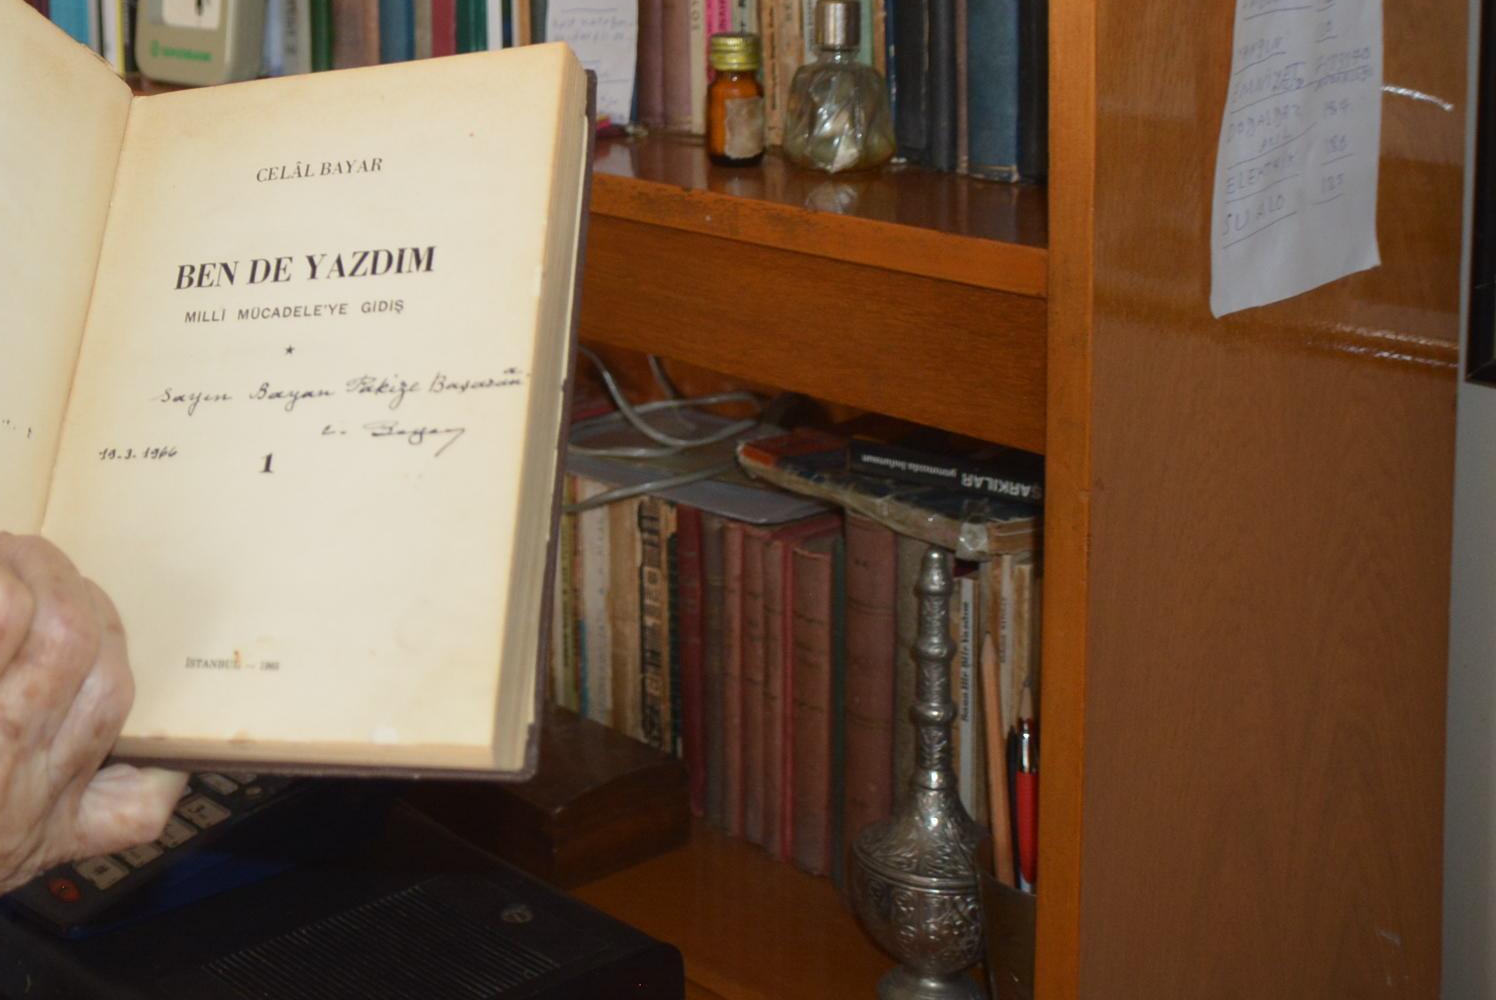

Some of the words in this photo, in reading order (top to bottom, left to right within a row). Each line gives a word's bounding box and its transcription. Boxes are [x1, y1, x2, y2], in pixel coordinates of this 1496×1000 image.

[256, 161, 315, 182] CELÂL
[319, 158, 383, 176] BAYAR
[174, 260, 239, 289] BEN
[247, 256, 293, 284] DE
[306, 246, 436, 280] YAZDIM
[259, 452, 275, 474] 1
